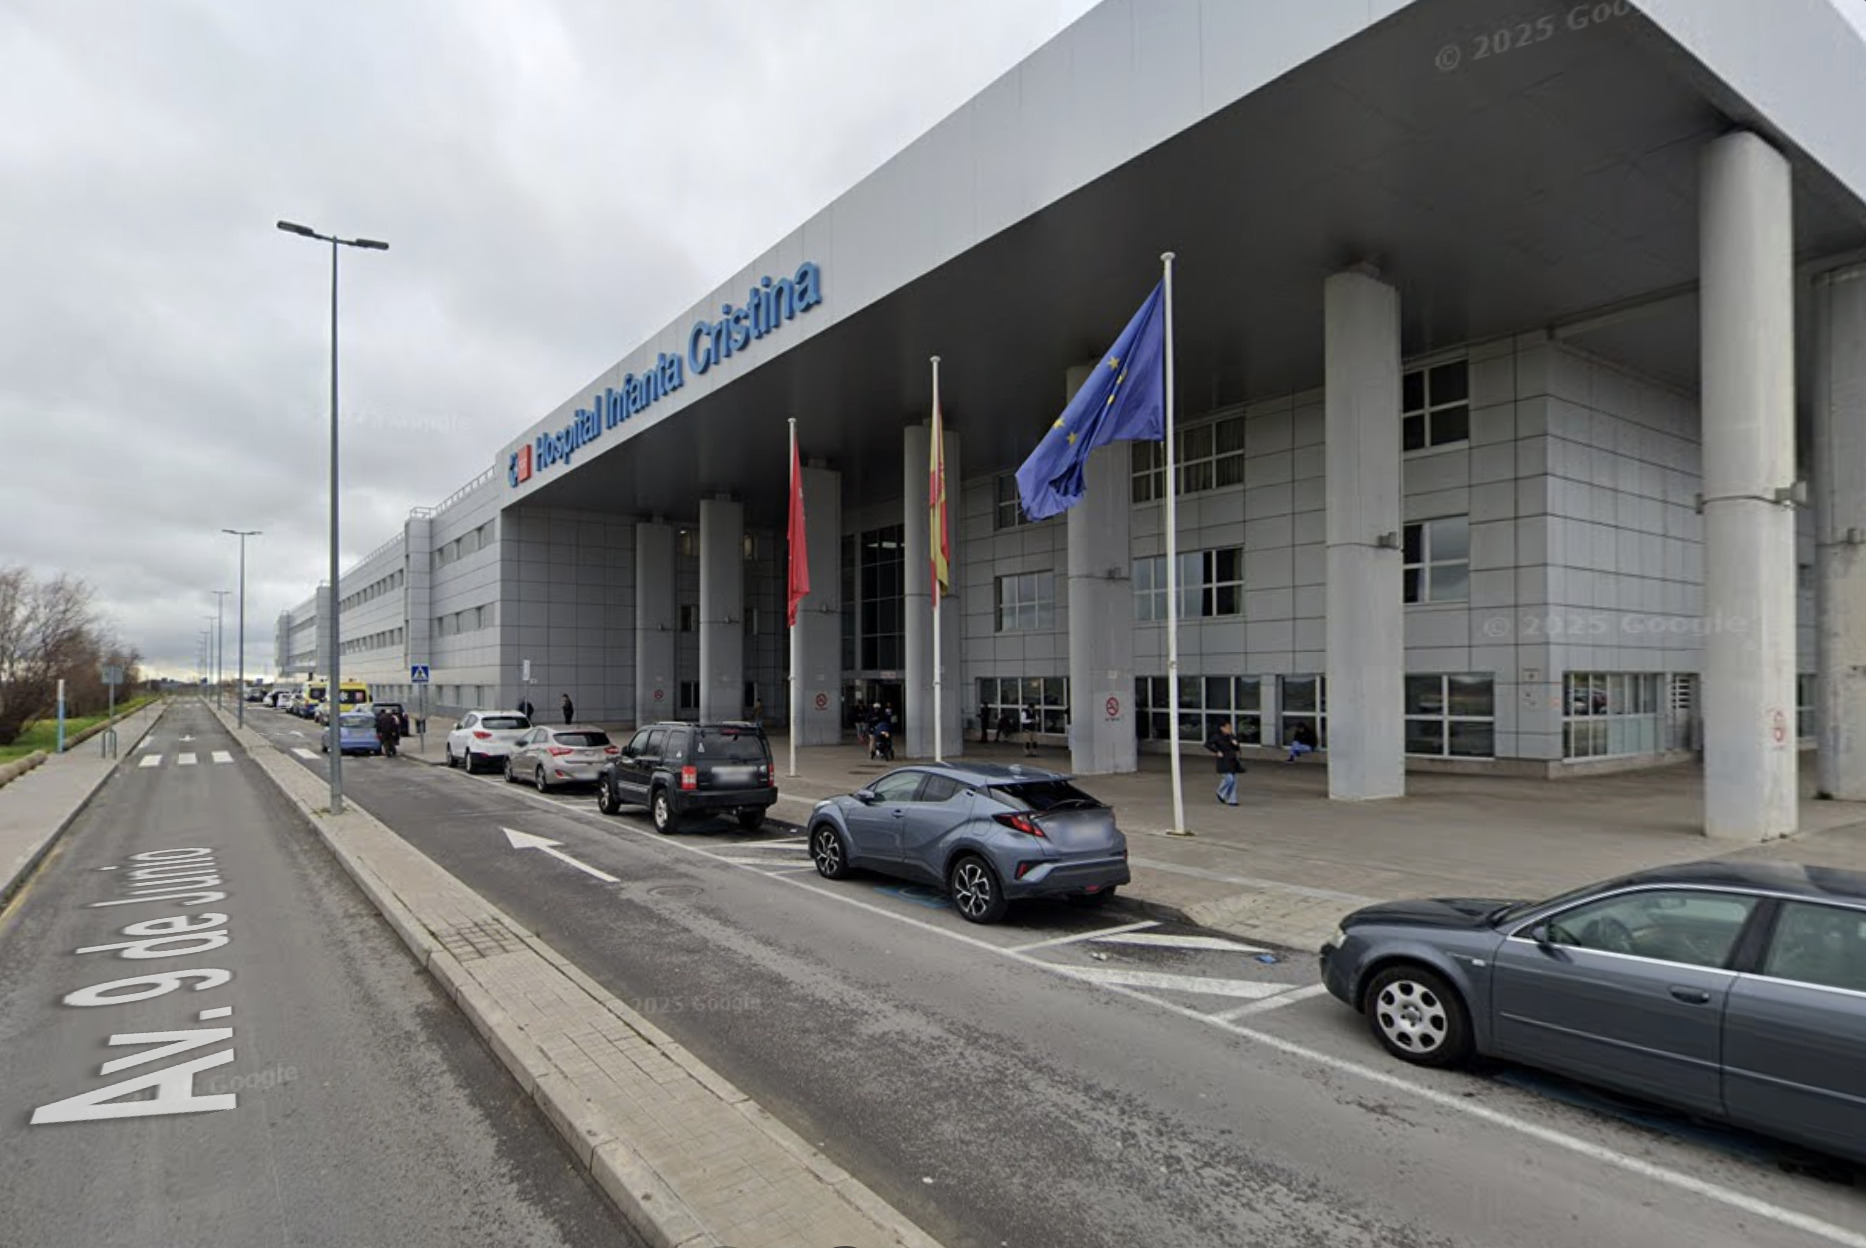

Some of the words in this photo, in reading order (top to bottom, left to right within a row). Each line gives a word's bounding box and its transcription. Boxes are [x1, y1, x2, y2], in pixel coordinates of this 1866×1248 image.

[536, 395, 602, 472] Hospital
[605, 353, 684, 430] Infanta
[688, 262, 822, 375] Cristina
